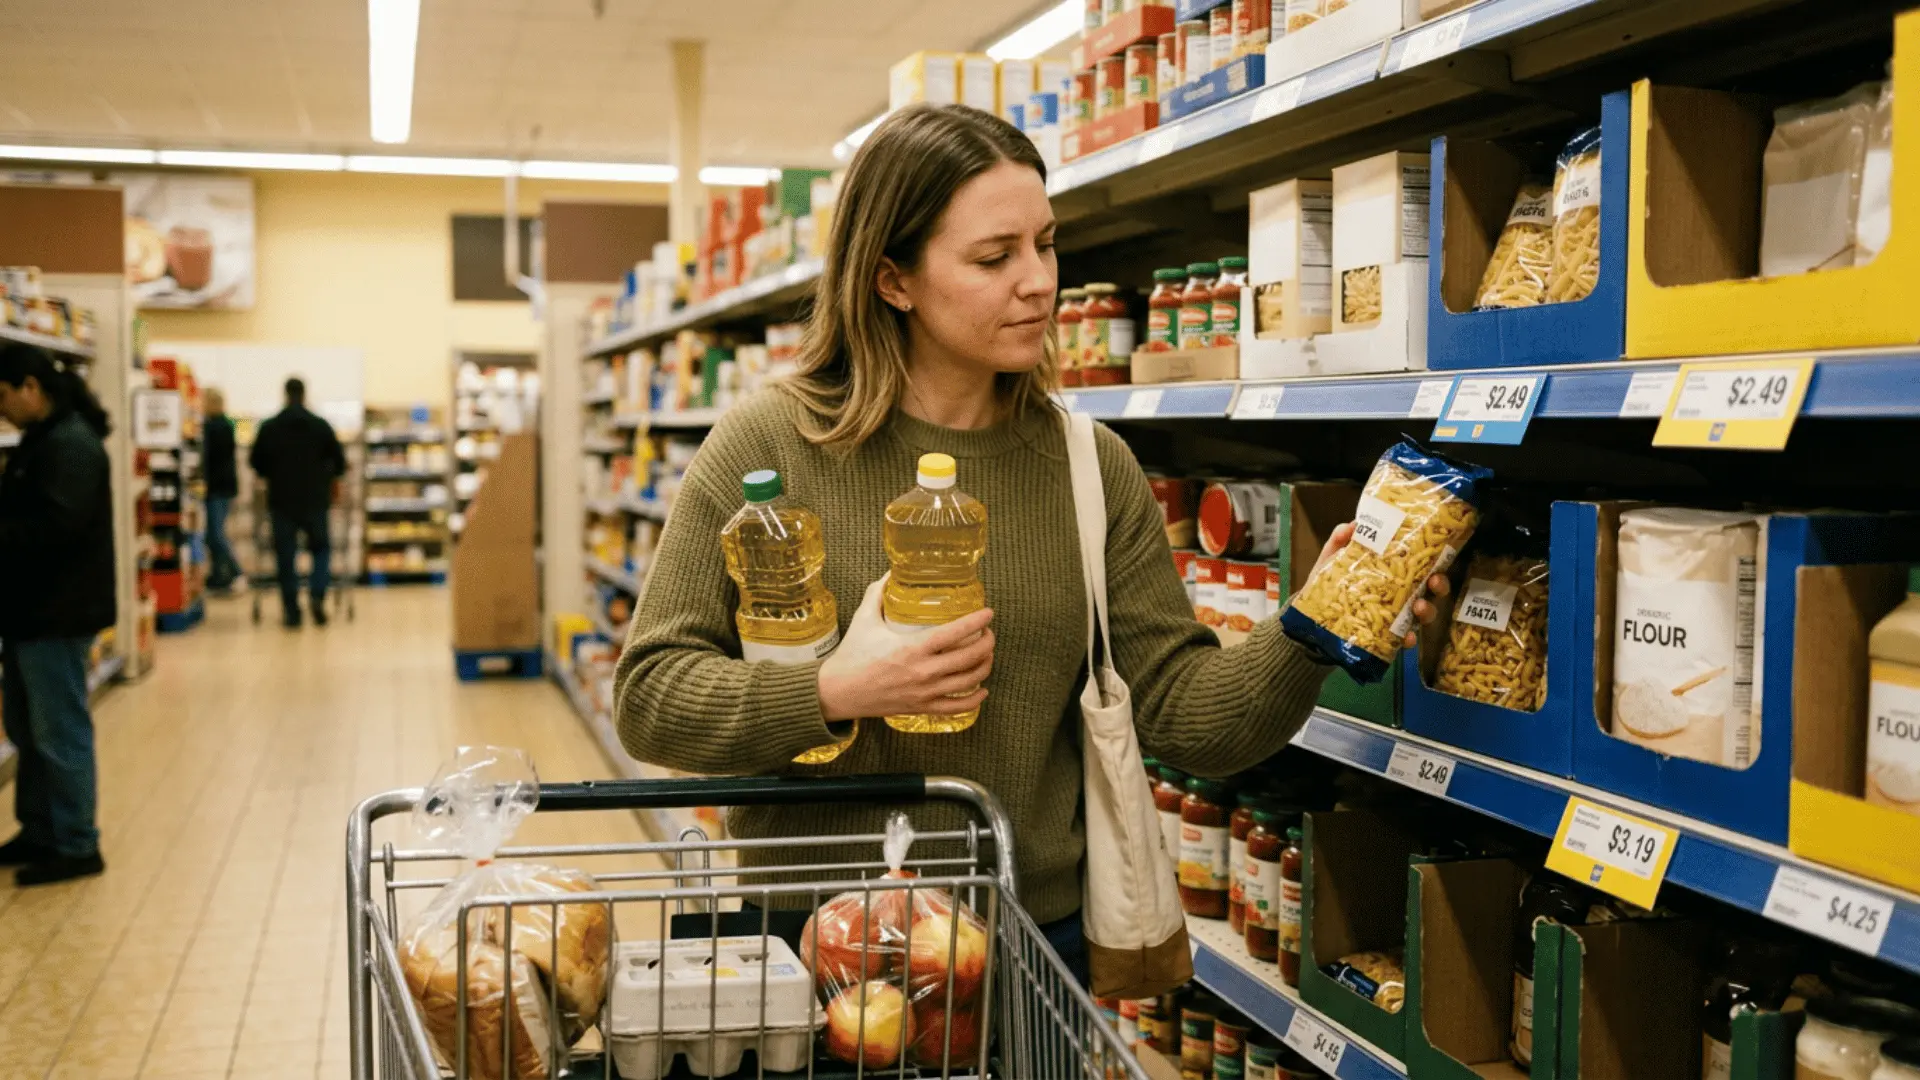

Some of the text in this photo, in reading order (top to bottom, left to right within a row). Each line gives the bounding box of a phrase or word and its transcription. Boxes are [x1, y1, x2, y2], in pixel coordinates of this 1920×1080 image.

[1486, 385, 1529, 410] $2.49
[1728, 376, 1788, 407] $2.49
[1623, 619, 1687, 648] FLOUR
[1608, 824, 1656, 863] $3.19
[1827, 896, 1880, 933] $4.25
